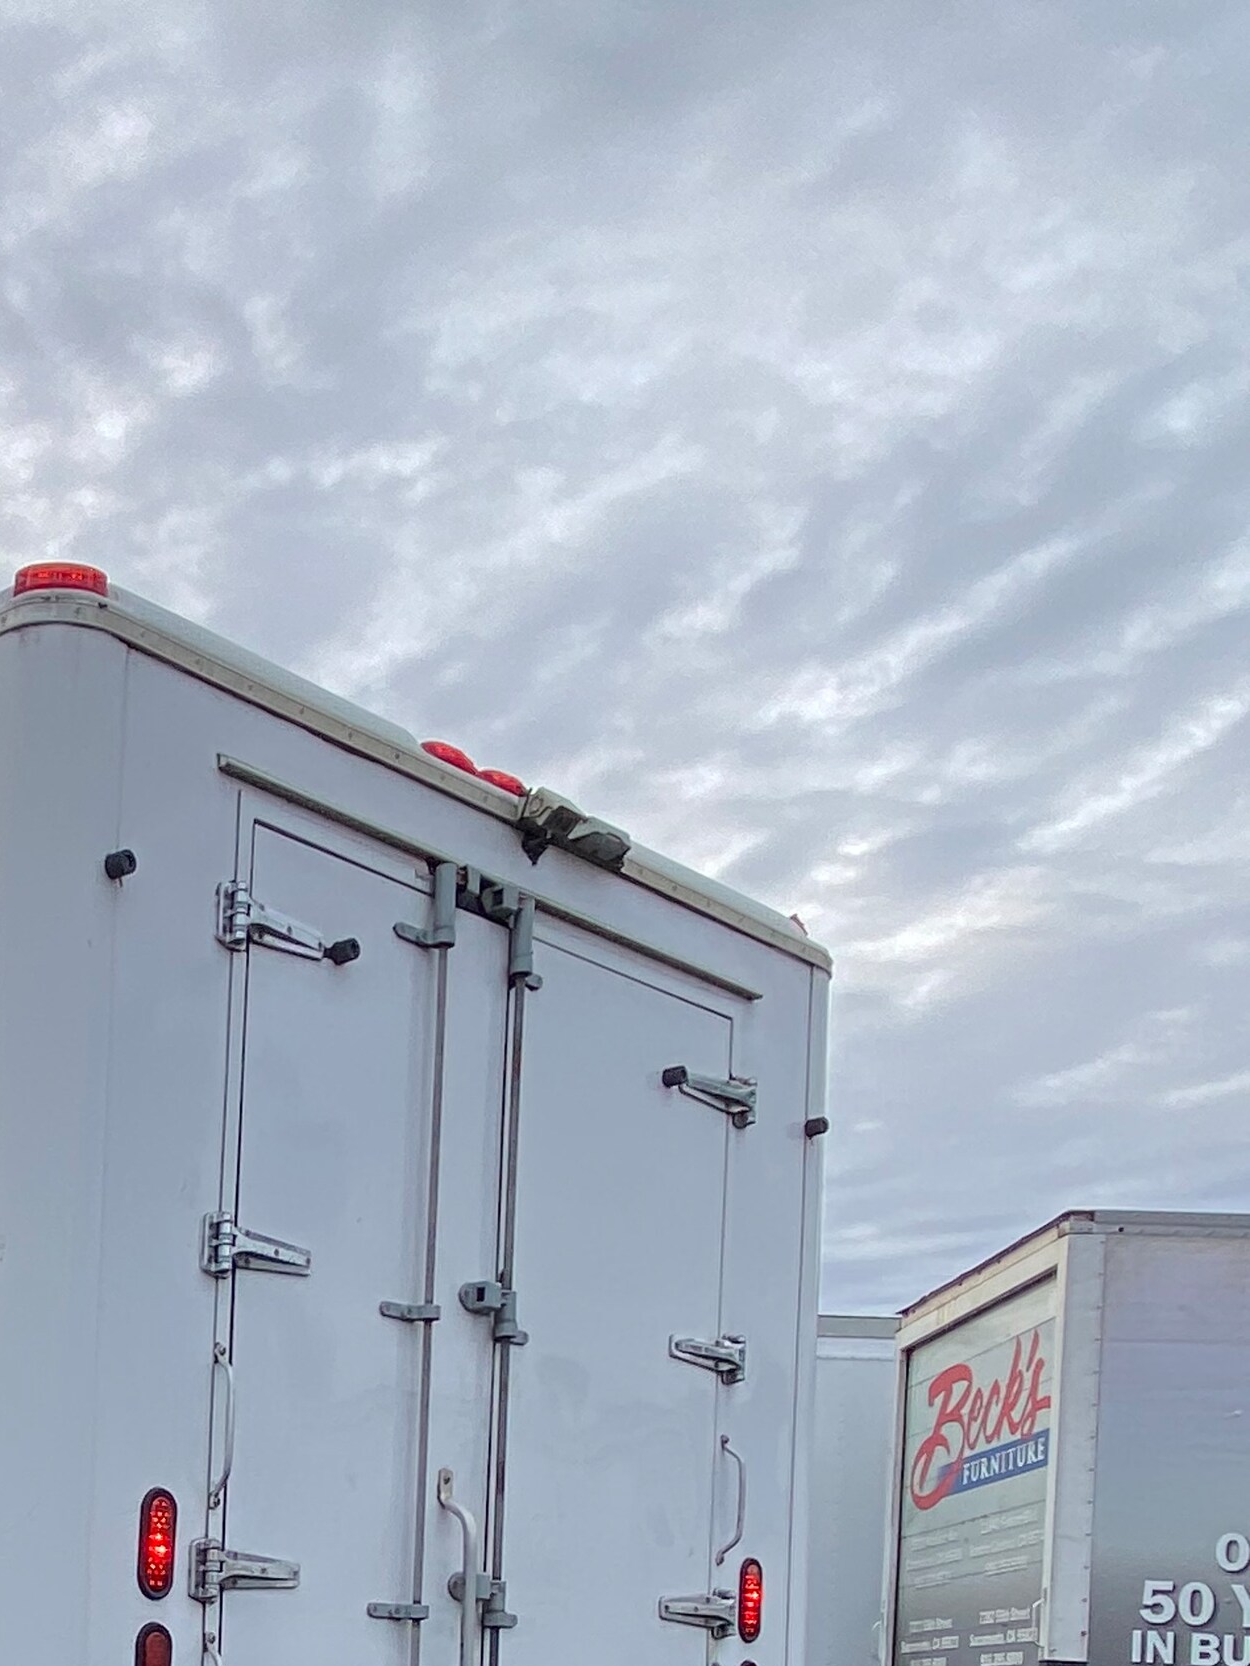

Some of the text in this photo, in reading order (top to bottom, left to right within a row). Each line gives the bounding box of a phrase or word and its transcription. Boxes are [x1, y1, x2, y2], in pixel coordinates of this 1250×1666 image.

[911, 1329, 1051, 1510] Beck's
[962, 1438, 1046, 1485] FURNITURE
[1139, 1580, 1215, 1626] 50
[1132, 1629, 1175, 1665] IN
